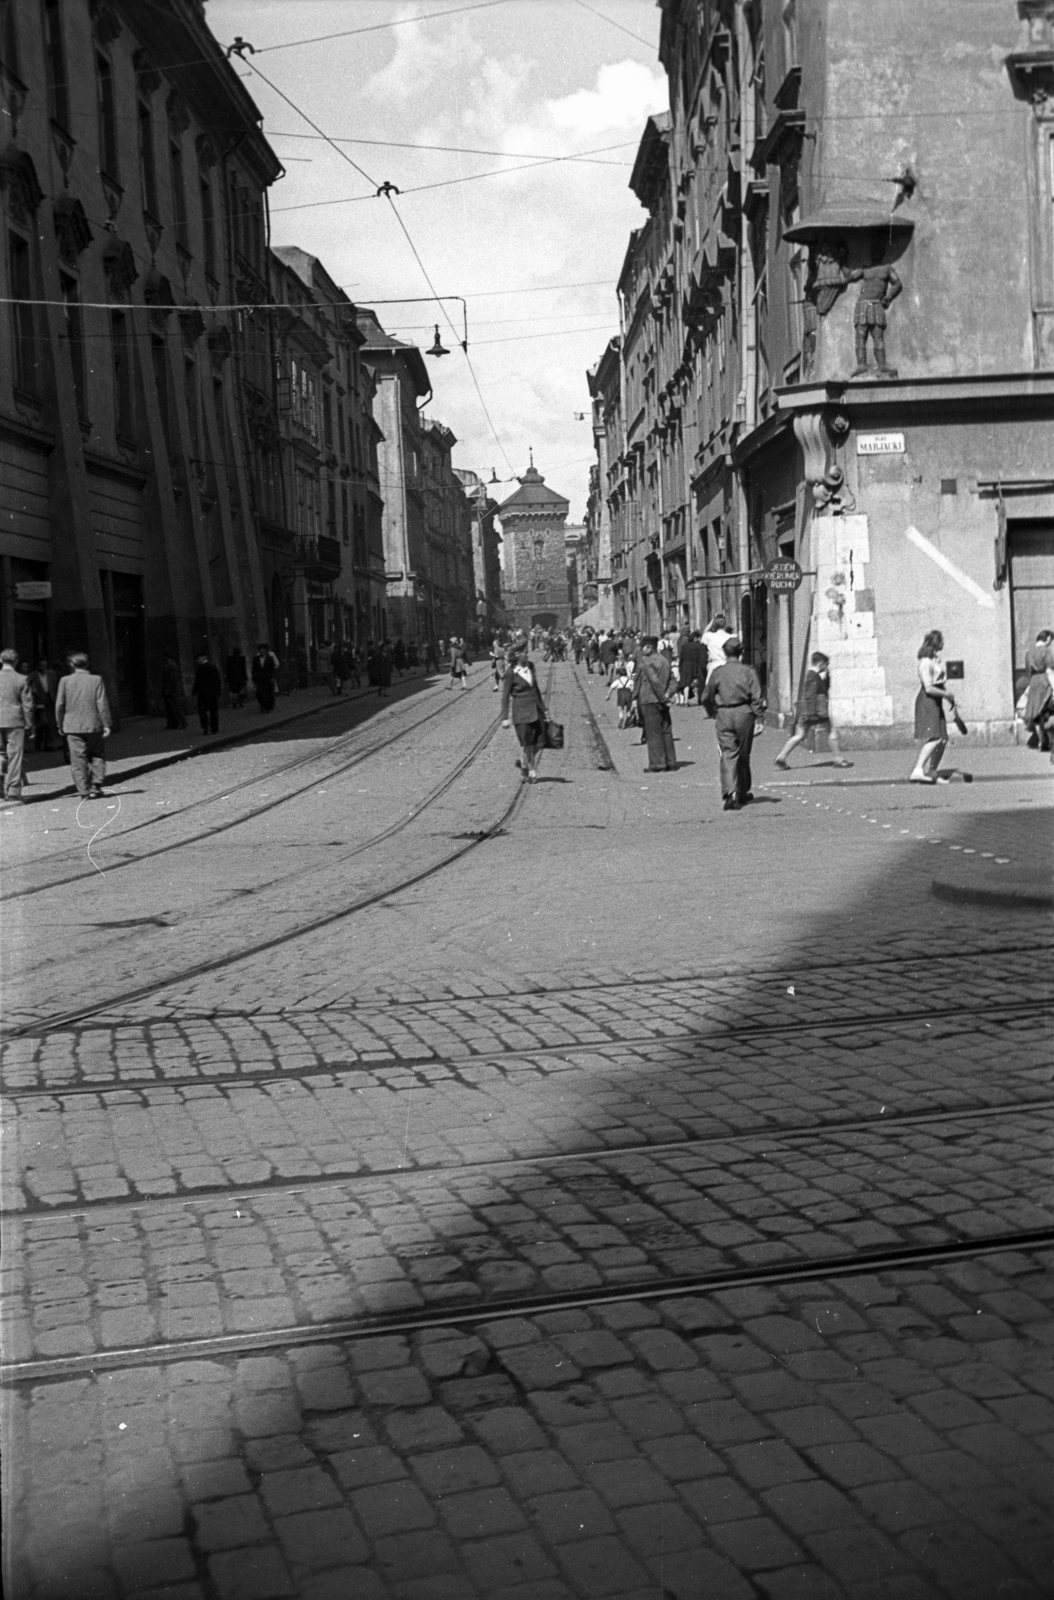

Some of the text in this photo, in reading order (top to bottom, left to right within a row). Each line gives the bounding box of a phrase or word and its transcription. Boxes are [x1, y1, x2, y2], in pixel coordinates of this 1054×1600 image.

[771, 563, 795, 571] JEDEN
[764, 571, 800, 580] KIERUNEK
[771, 580, 795, 588] RUCHU
